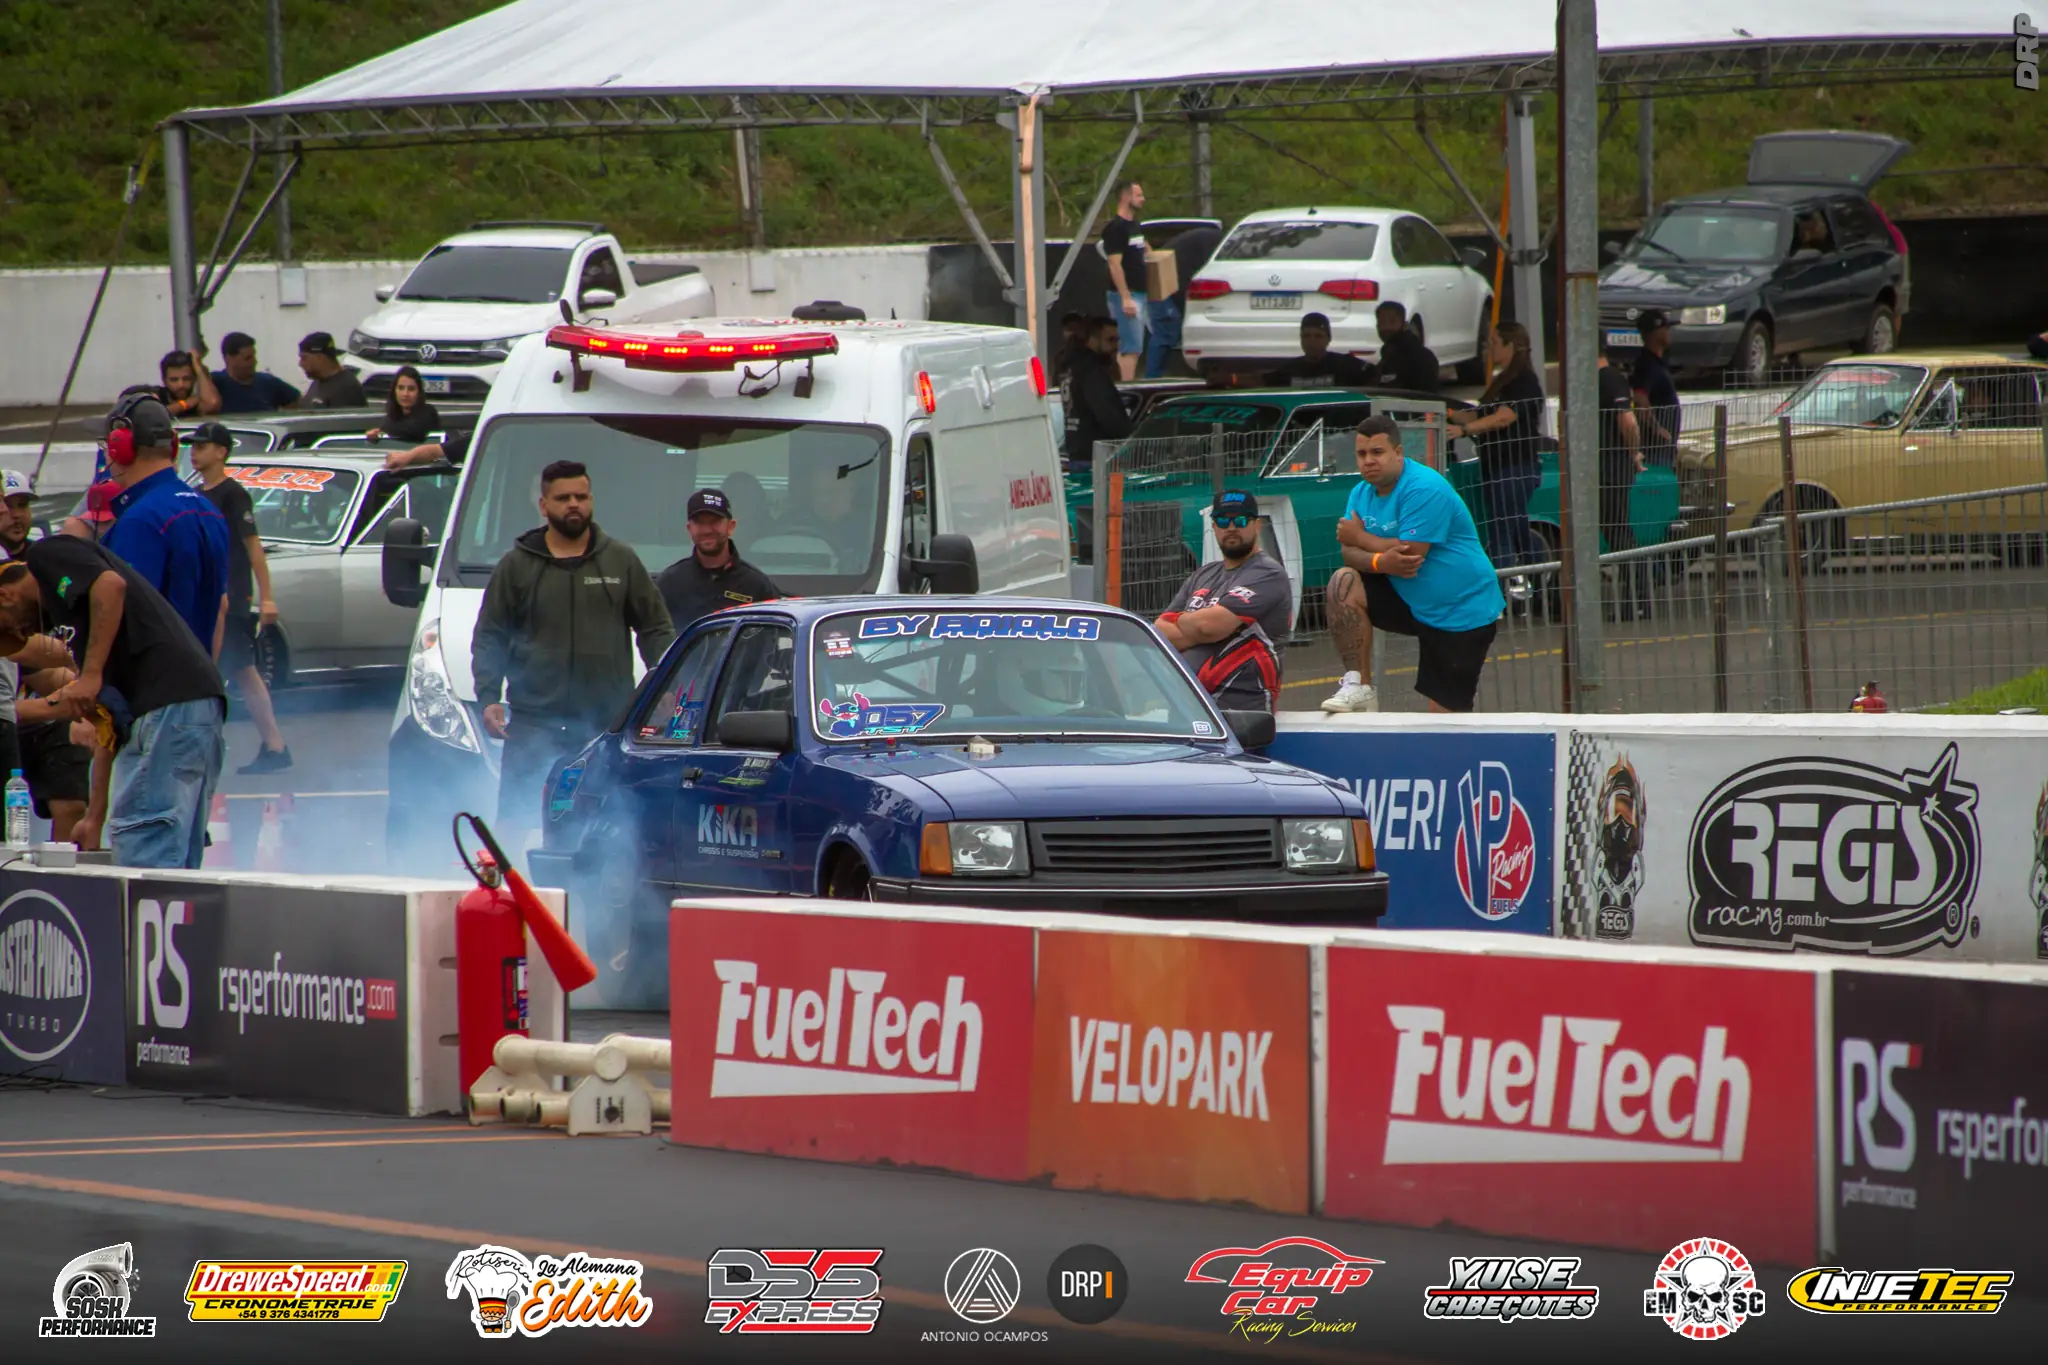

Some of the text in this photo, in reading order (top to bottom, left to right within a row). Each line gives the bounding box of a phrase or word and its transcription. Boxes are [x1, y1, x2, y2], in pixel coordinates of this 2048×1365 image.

[858, 615, 930, 638] BY
[1344, 778, 1447, 850] WER!
[1458, 761, 1513, 915] VP
[1731, 801, 1938, 907] REGIS
[1491, 843, 1533, 897] Racing
[1491, 898, 1521, 914] FUELS
[36, 919, 83, 1001] POWER
[137, 898, 194, 1030] RS
[7, 1012, 60, 1033] TURBO
[136, 1036, 190, 1067] performance
[713, 959, 983, 1092] FuelTech
[1070, 1015, 1273, 1122] VELOPARK
[1386, 1005, 1751, 1162] FuelTech
[1841, 1037, 1922, 1172] RS
